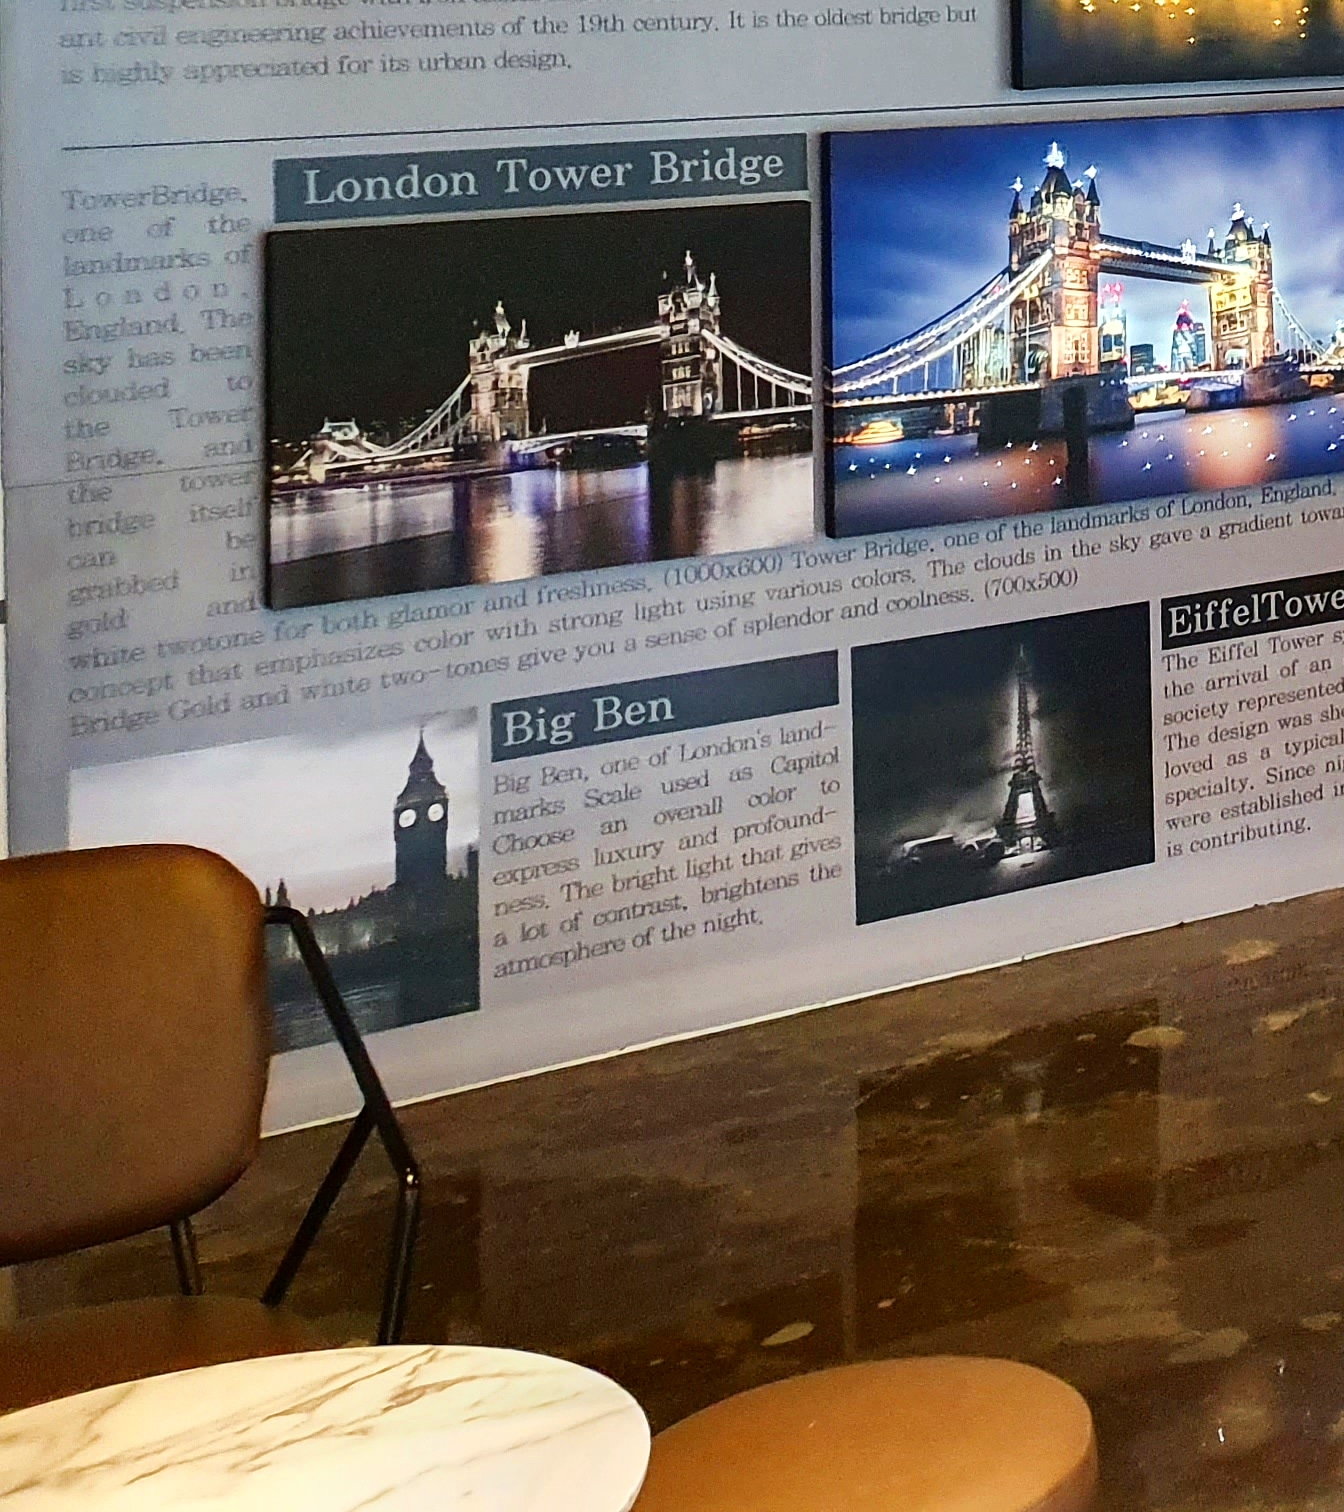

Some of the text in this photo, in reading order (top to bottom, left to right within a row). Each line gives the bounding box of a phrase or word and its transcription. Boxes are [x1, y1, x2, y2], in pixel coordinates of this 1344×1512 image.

[304, 148, 785, 205] London Tower Bridge
[168, 694, 231, 721] Gold
[241, 686, 289, 711] and
[517, 647, 567, 673] give
[573, 639, 616, 665] you
[623, 633, 637, 653] a
[646, 626, 707, 650] sense
[715, 616, 740, 639] of
[743, 604, 835, 637] splendor
[840, 595, 880, 618] and
[1162, 654, 1198, 672] The
[1208, 643, 1259, 665] Eiffel
[1268, 631, 1324, 654] Tower
[1164, 681, 1194, 698] the
[1206, 665, 1268, 691] arrival
[1280, 663, 1299, 678] of
[1310, 659, 1331, 672] an
[503, 695, 674, 747] Big Ben
[1164, 699, 1228, 726] society
[1164, 733, 1200, 752] The
[1208, 721, 1268, 744] design
[1278, 714, 1312, 729] was
[494, 771, 531, 795] Big
[600, 755, 639, 775] one
[649, 746, 672, 766] of
[1165, 755, 1213, 778] loved
[1227, 752, 1247, 766] as
[1260, 747, 1270, 760] a
[1285, 729, 1344, 757] typical
[1266, 764, 1315, 785] Since
[1166, 810, 1211, 830] were
[1221, 785, 1323, 821] established
[1167, 841, 1182, 857] is
[494, 935, 625, 978] atmosphere
[632, 927, 655, 949] of
[662, 920, 696, 941] the
